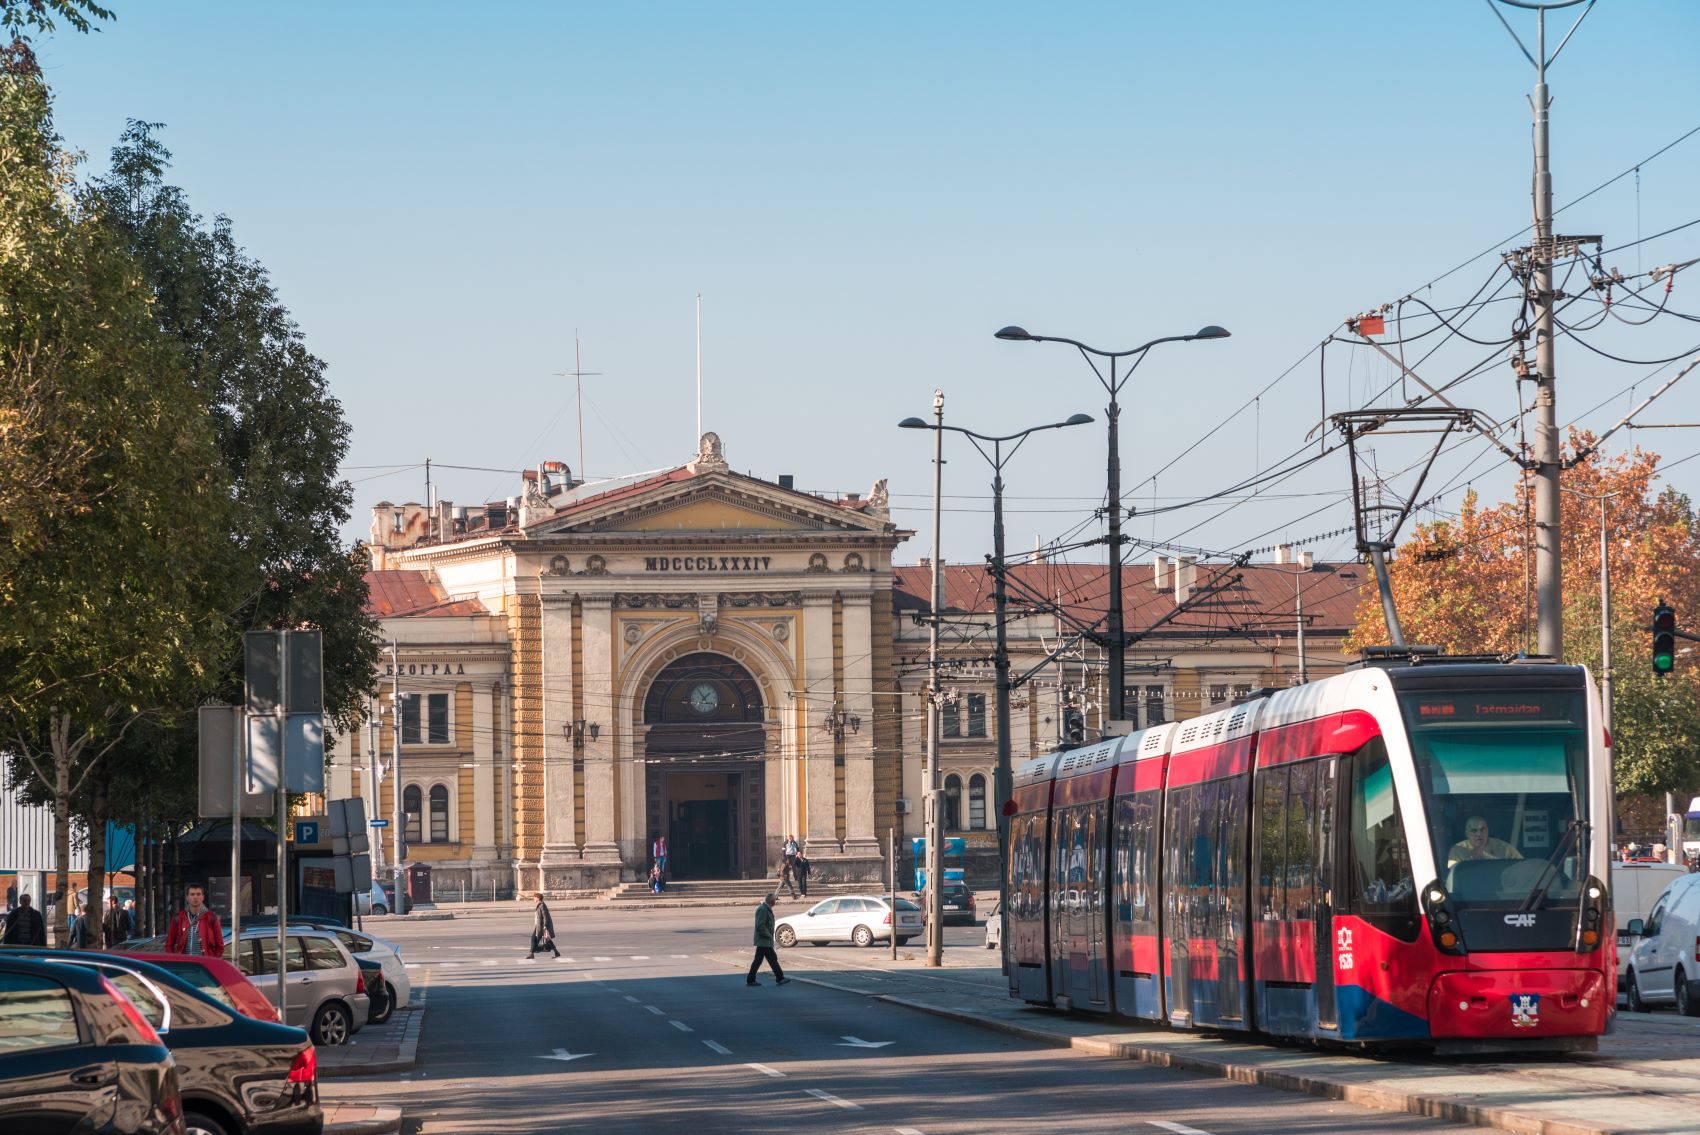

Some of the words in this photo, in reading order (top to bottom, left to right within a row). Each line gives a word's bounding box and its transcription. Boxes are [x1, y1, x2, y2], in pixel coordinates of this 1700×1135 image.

[644, 556, 772, 571] MDCCCLXXXIV
[386, 663, 465, 676] БЕОГРАД
[302, 826, 314, 840] P
[1503, 914, 1536, 927] CAF
